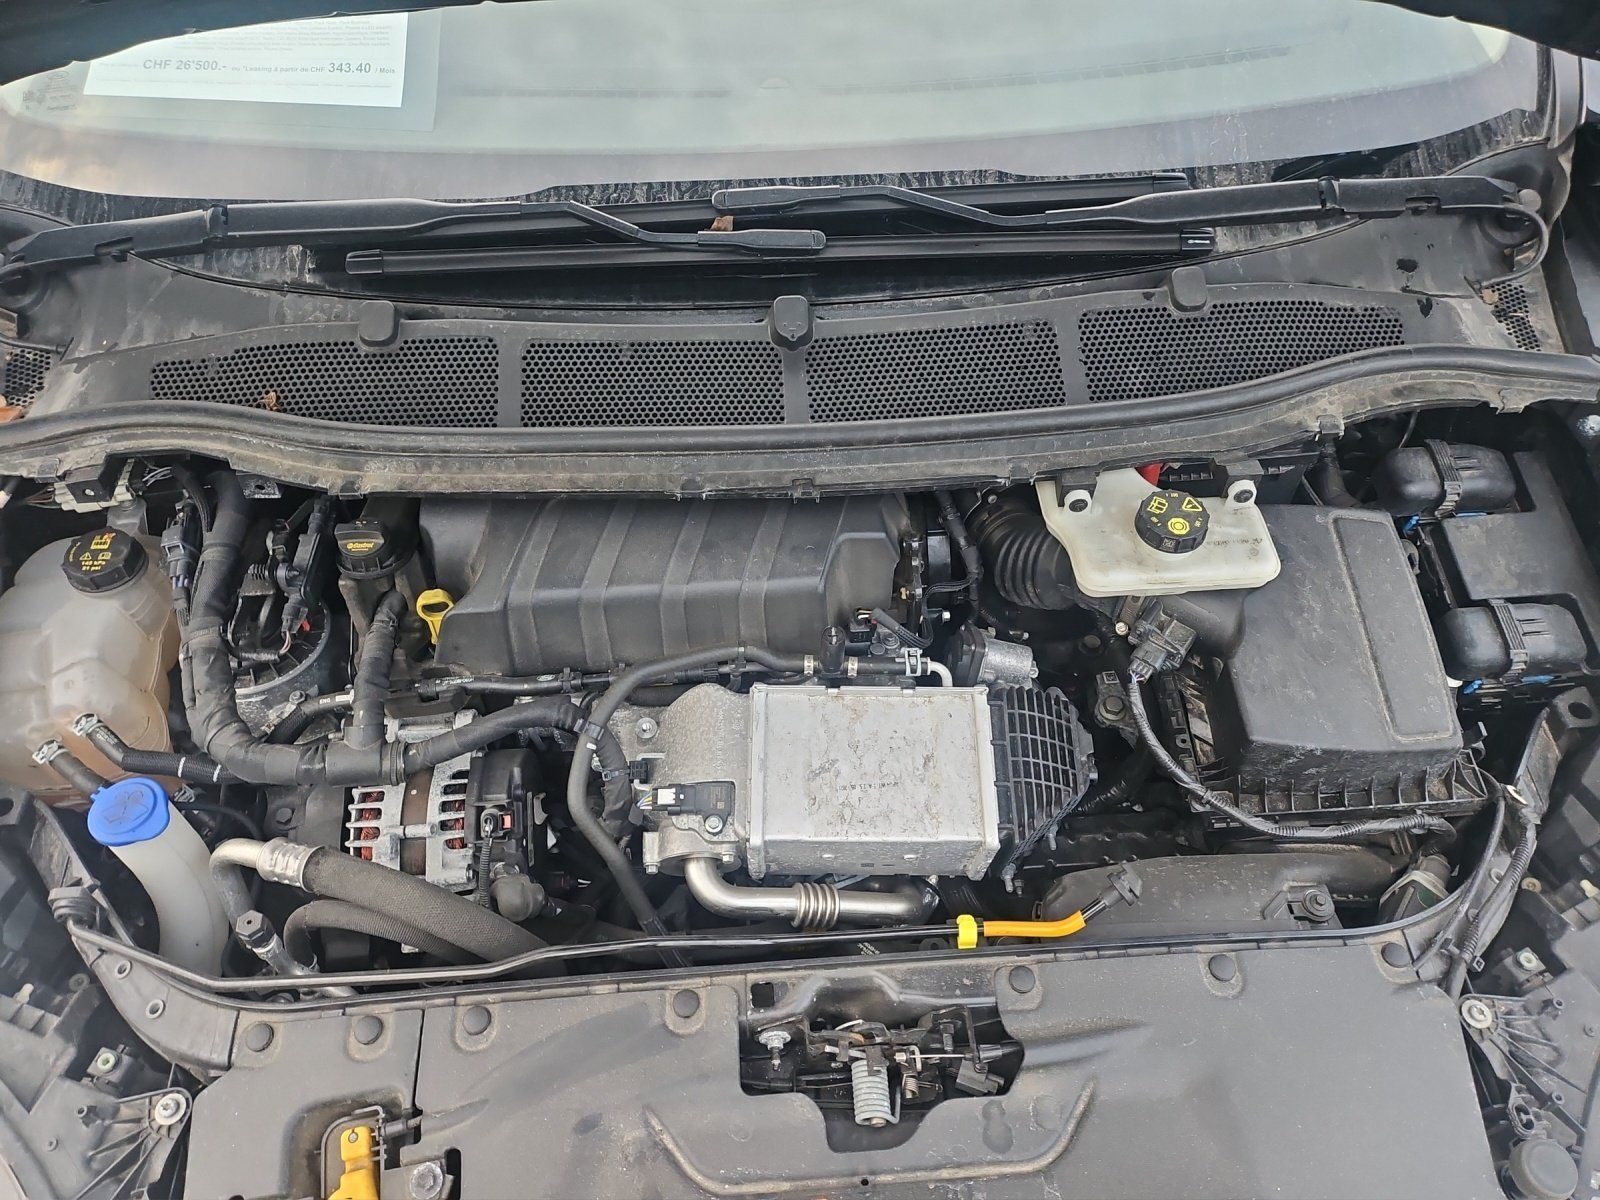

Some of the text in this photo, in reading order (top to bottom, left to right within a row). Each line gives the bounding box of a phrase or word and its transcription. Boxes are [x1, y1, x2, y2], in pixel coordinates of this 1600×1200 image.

[143, 59, 172, 70] CHF
[176, 59, 227, 71] 26'500.-
[311, 65, 325, 73] CHF
[328, 62, 371, 74] 343.40
